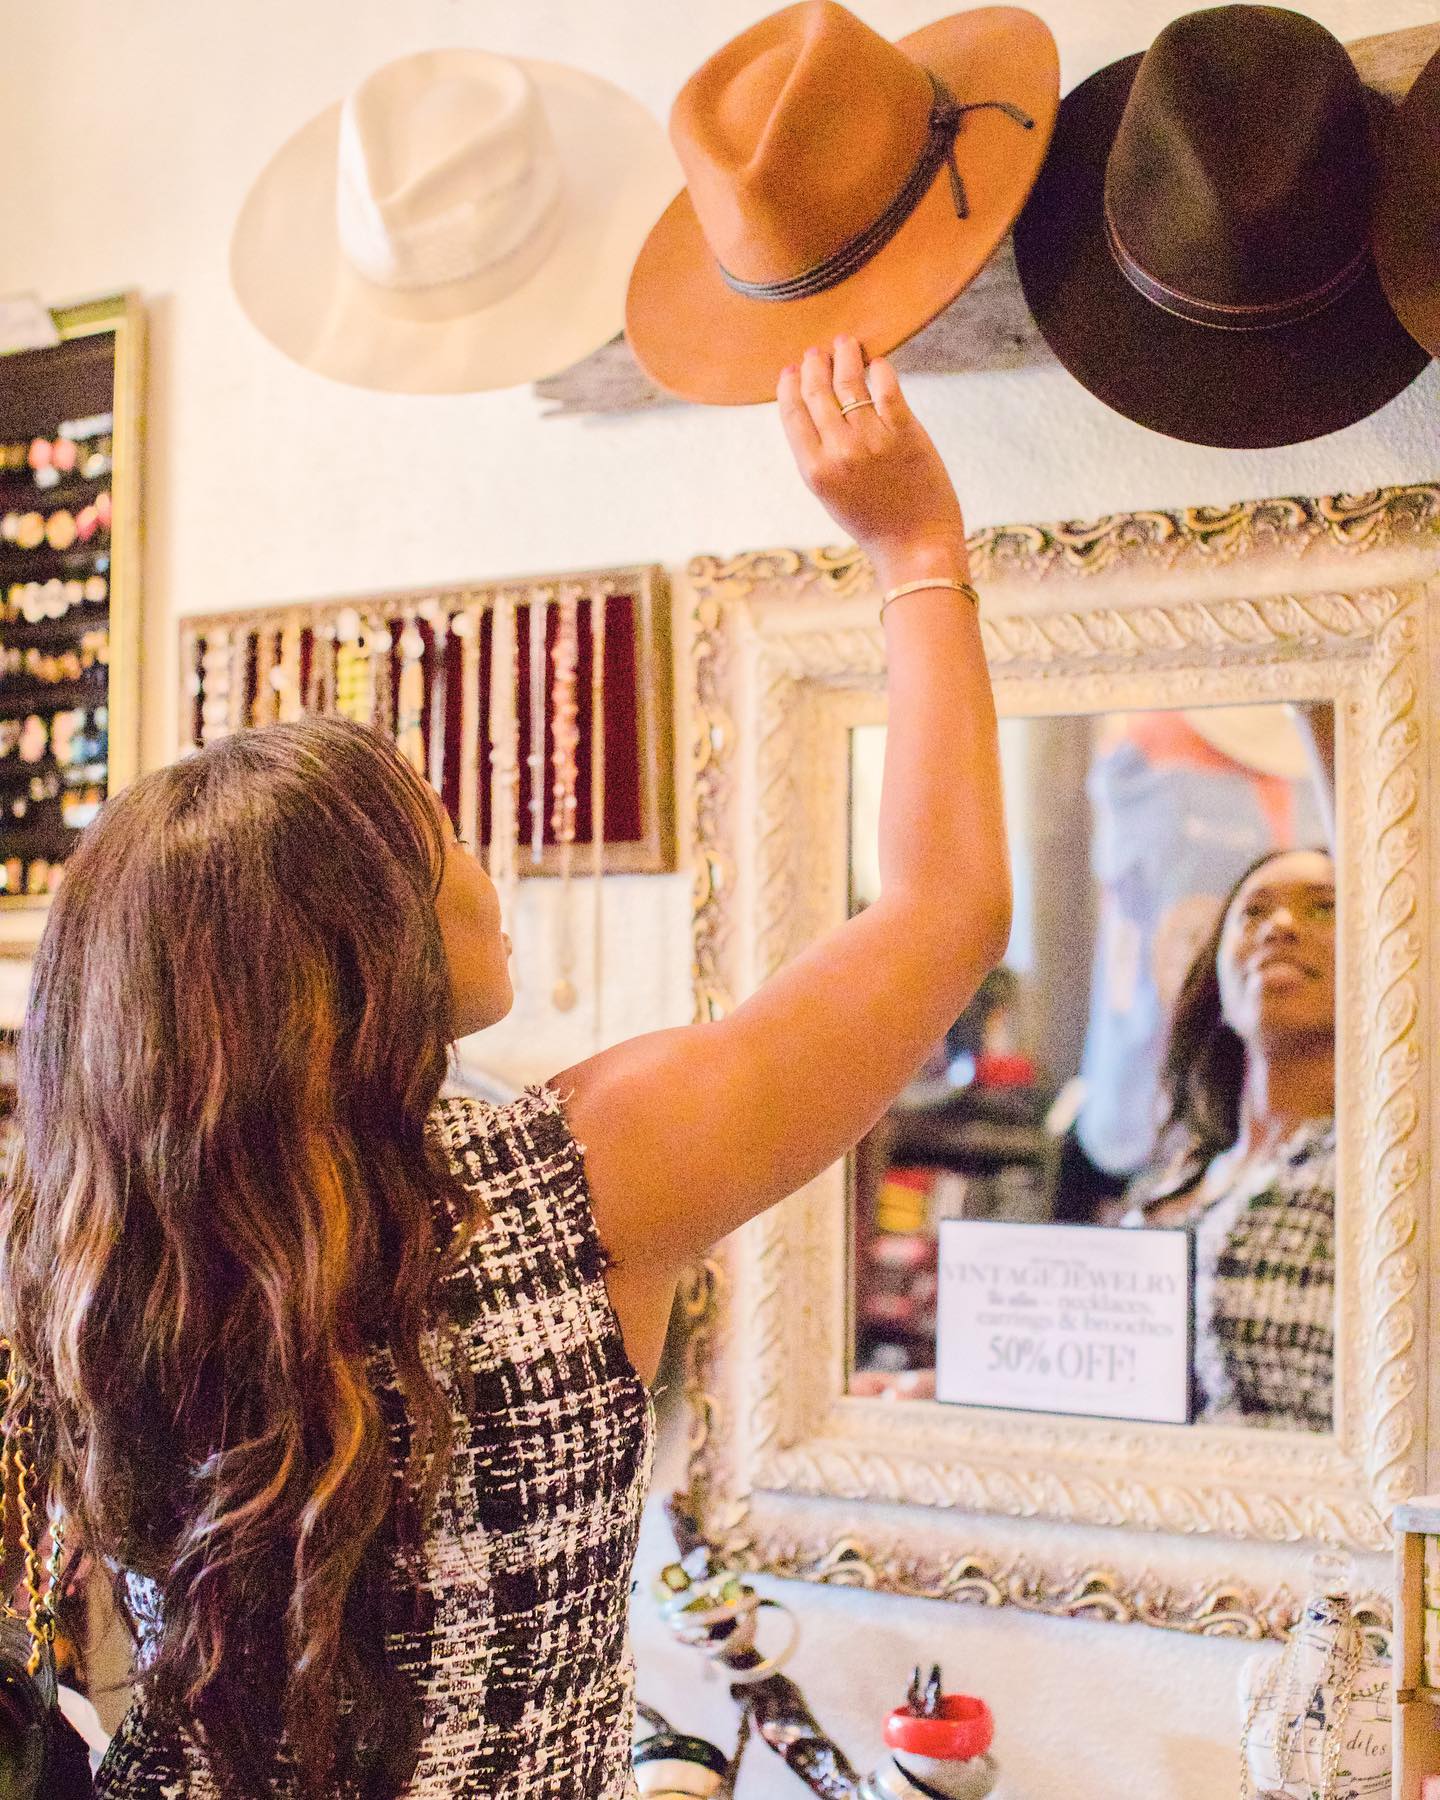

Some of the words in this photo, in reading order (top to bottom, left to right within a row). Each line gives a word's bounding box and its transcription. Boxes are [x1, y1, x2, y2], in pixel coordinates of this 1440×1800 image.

[1061, 1267, 1180, 1296] JEWELRY
[1057, 1312, 1077, 1332] &
[986, 1335, 1051, 1376] 50%
[1057, 1341, 1137, 1383] OFF!
